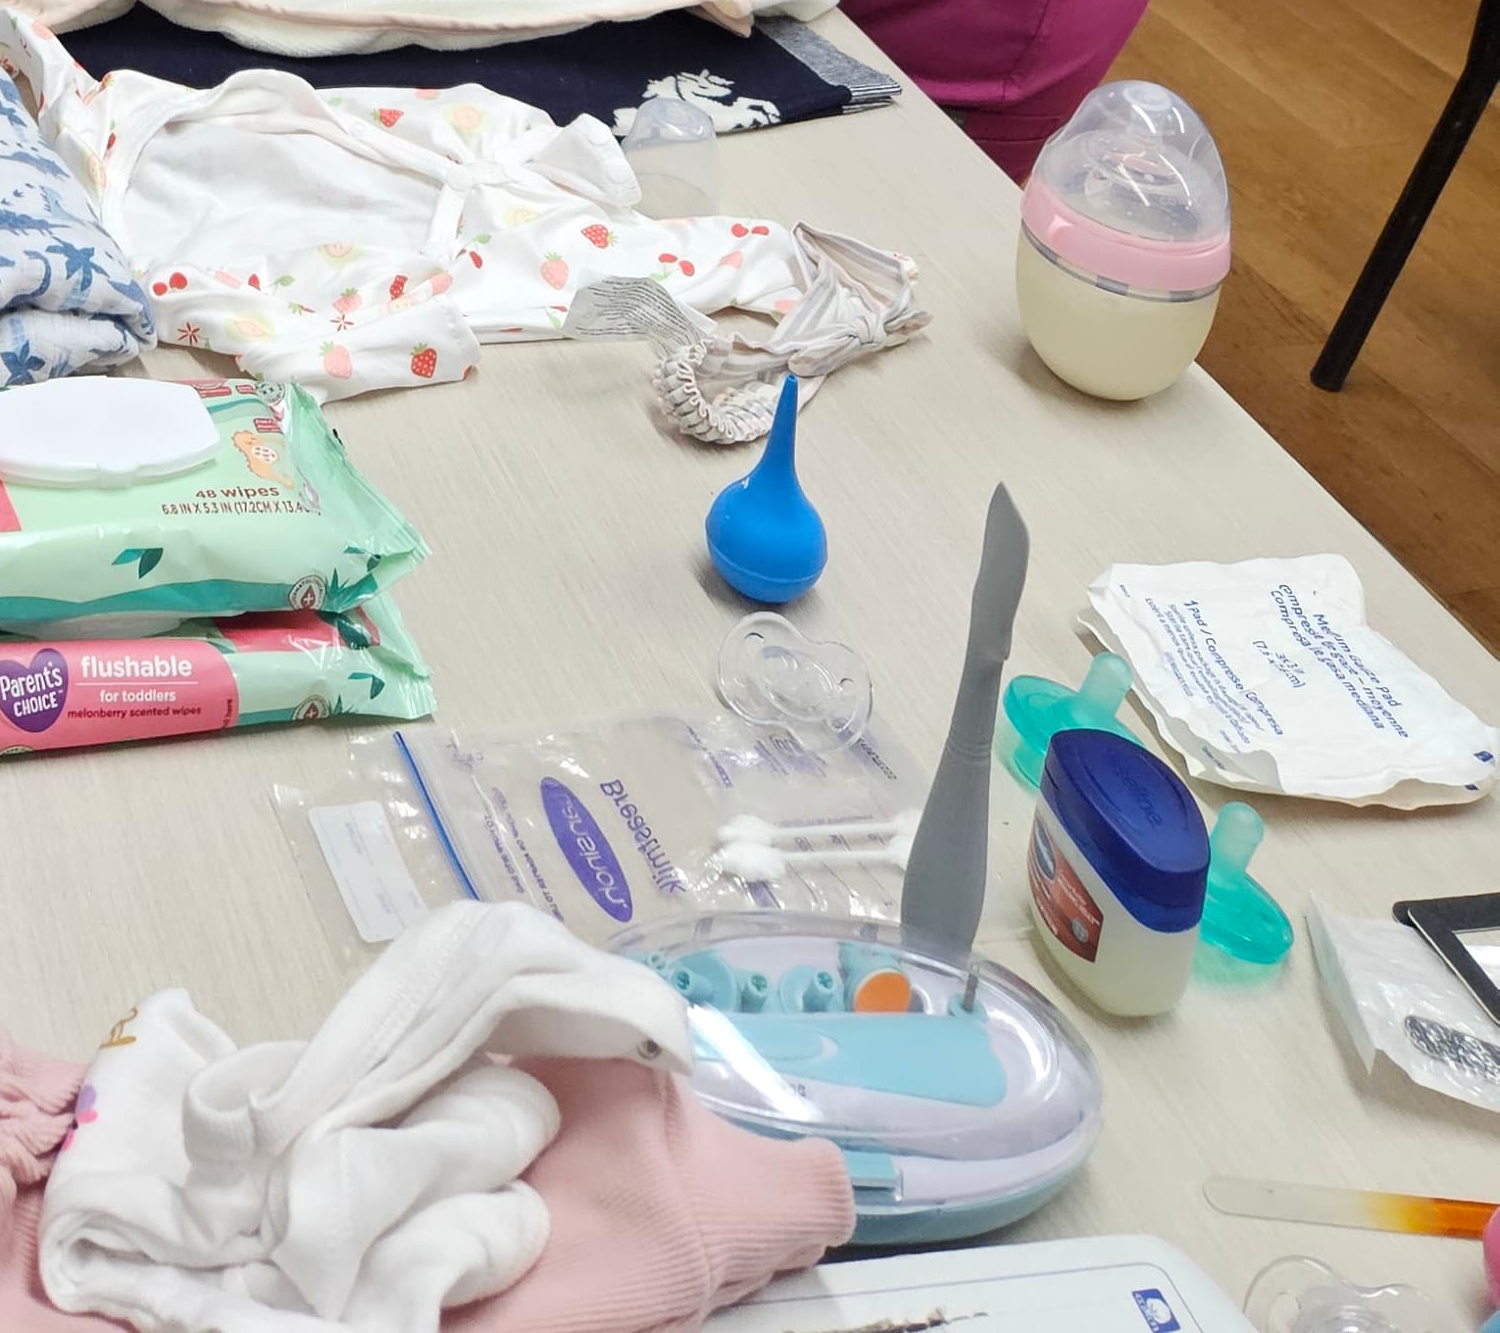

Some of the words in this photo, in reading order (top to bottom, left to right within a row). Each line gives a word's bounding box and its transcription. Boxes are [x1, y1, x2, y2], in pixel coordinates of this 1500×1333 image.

[196, 490, 217, 499] 48
[220, 486, 280, 499] wipes
[162, 502, 178, 515] 6.8
[181, 502, 191, 514] IN
[192, 502, 201, 513] X
[205, 502, 219, 513] 5.3
[221, 502, 232, 513] IN
[235, 501, 270, 515] (17.2CM
[275, 501, 282, 513] X
[1190, 607, 1207, 627] Pad
[81, 655, 192, 678] flushable
[1270, 590, 1311, 647] Compresa
[1342, 681, 1384, 729] mediana
[1313, 614, 1351, 653] Meum
[1375, 686, 1403, 707] Pad
[0, 661, 63, 701] Parent's
[13, 692, 58, 717] CHOICE
[100, 690, 118, 703] for
[121, 690, 177, 702] toddlers
[67, 708, 127, 720] melonberry
[129, 707, 169, 718] scented
[172, 707, 202, 717] wipes
[1363, 687, 1408, 738] moyenne
